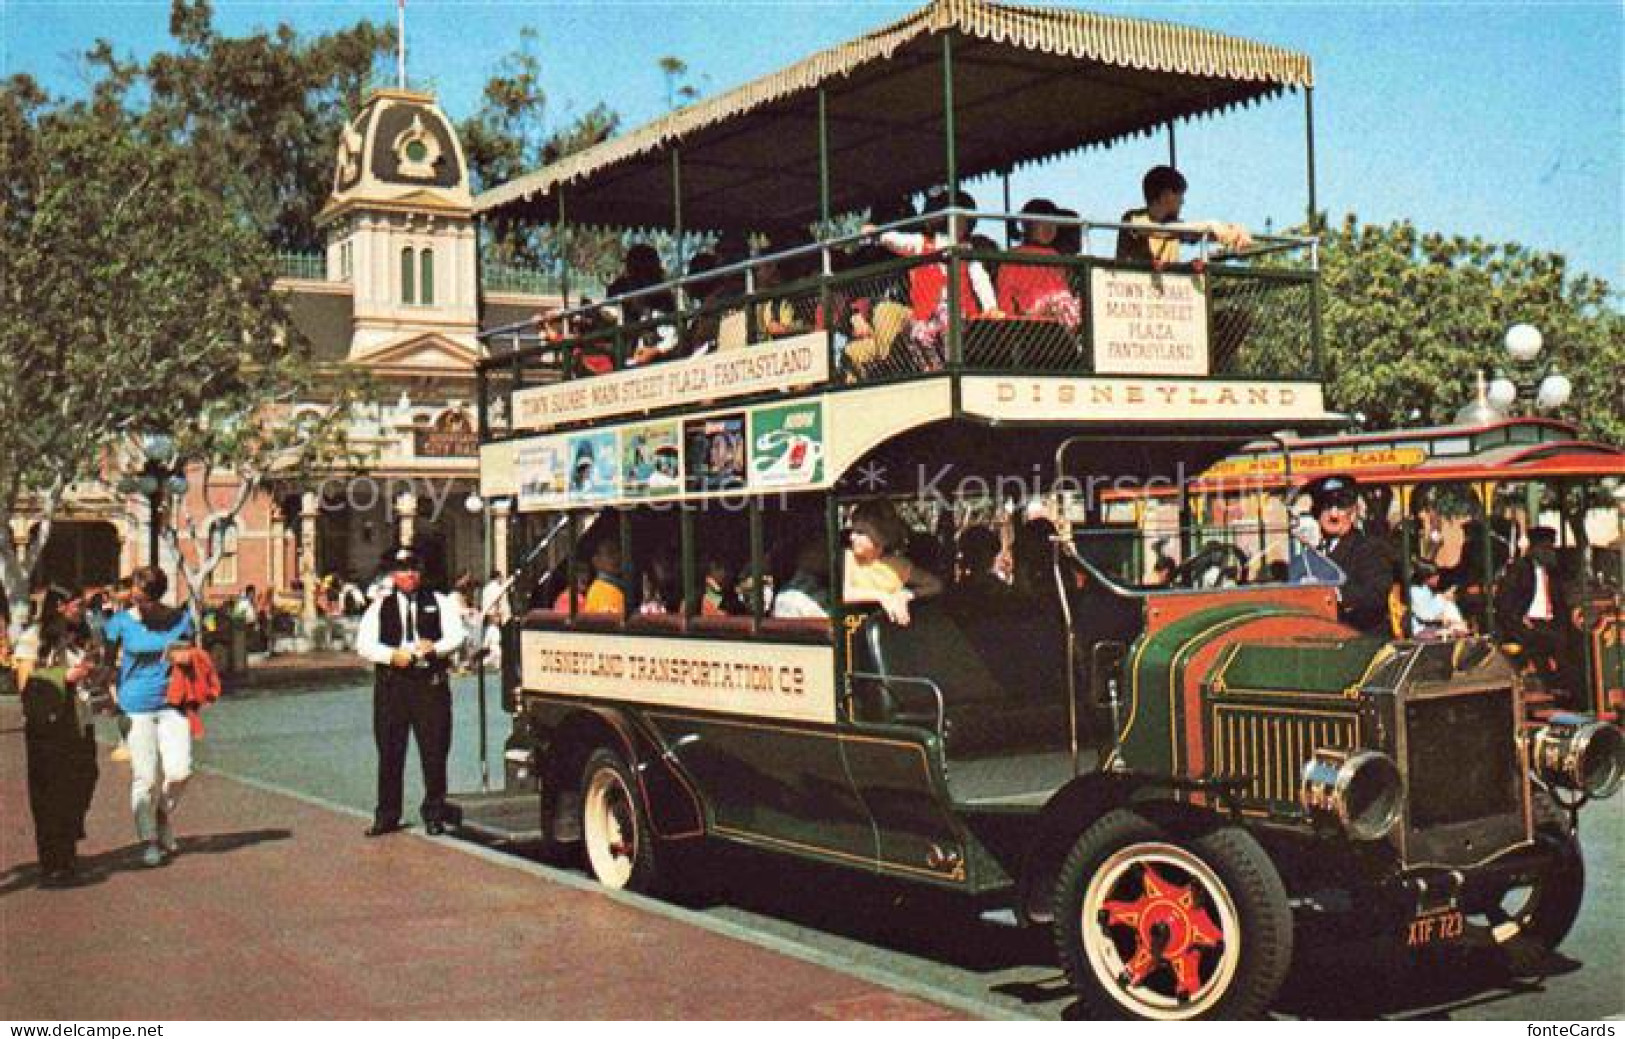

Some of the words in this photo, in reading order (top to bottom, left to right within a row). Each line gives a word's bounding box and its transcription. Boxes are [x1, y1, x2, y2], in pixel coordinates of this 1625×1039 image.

[1106, 301, 1143, 318] MAIN
[1146, 304, 1194, 321] STREET
[1129, 322, 1173, 340] PLAZA
[1108, 341, 1195, 360] FANTASYLAND
[622, 374, 665, 402] STREET
[668, 367, 708, 394] PLAZA
[714, 347, 811, 385] FANTASYLAND
[997, 383, 1296, 405] DISNEYLAND
[1290, 455, 1333, 467] TREET
[1351, 452, 1397, 464] PLAZA
[541, 649, 623, 678] DISNEYLAND
[628, 655, 774, 691] TRANSPORTATION
